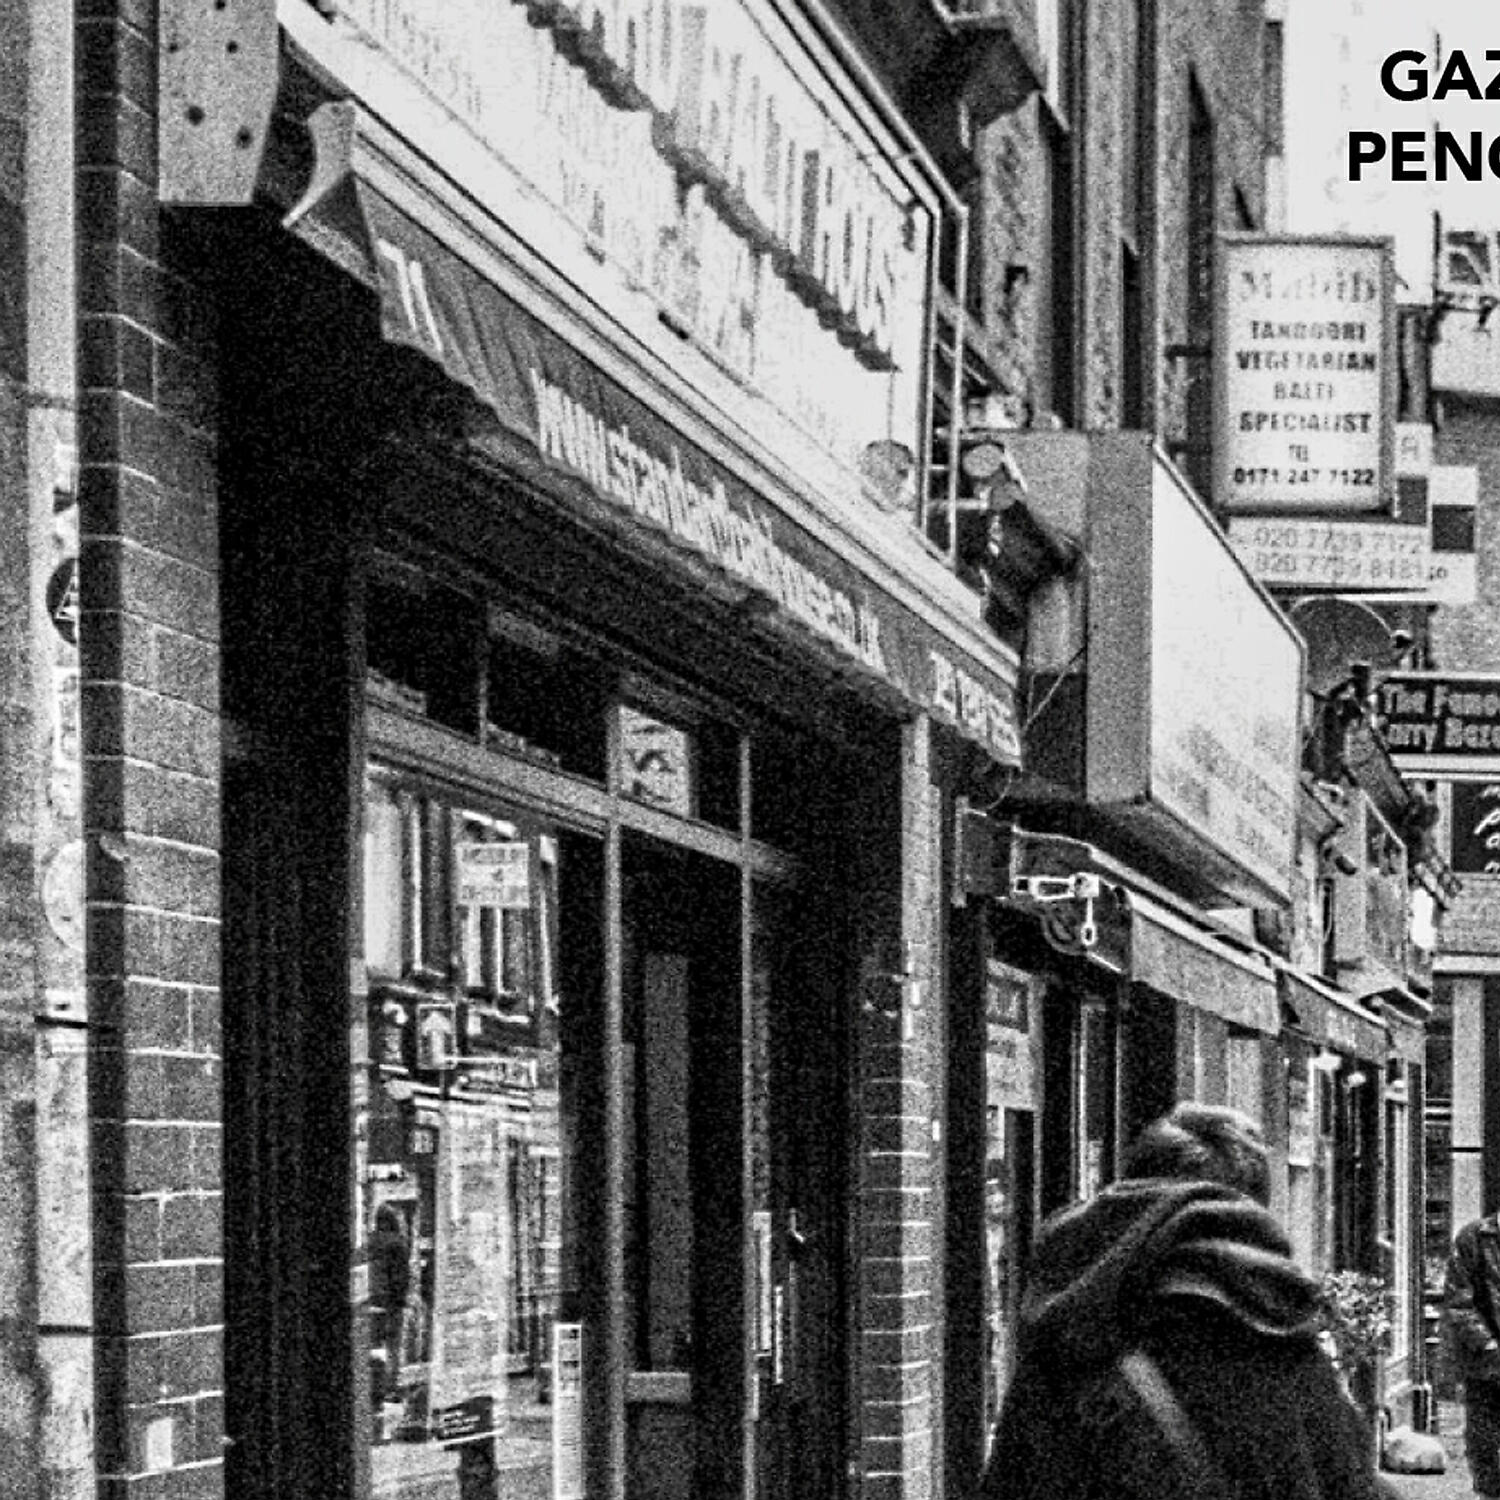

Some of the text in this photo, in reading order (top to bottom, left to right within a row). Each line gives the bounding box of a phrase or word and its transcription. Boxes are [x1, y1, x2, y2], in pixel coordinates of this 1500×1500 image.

[1250, 320, 1367, 343] TANDOORI
[1235, 349, 1377, 371] VEGETARIAN
[1273, 381, 1335, 401] BALTI
[1238, 410, 1372, 434] SPECIALIST
[1233, 466, 1376, 487] 0171 247 7122
[1381, 683, 1427, 714] The
